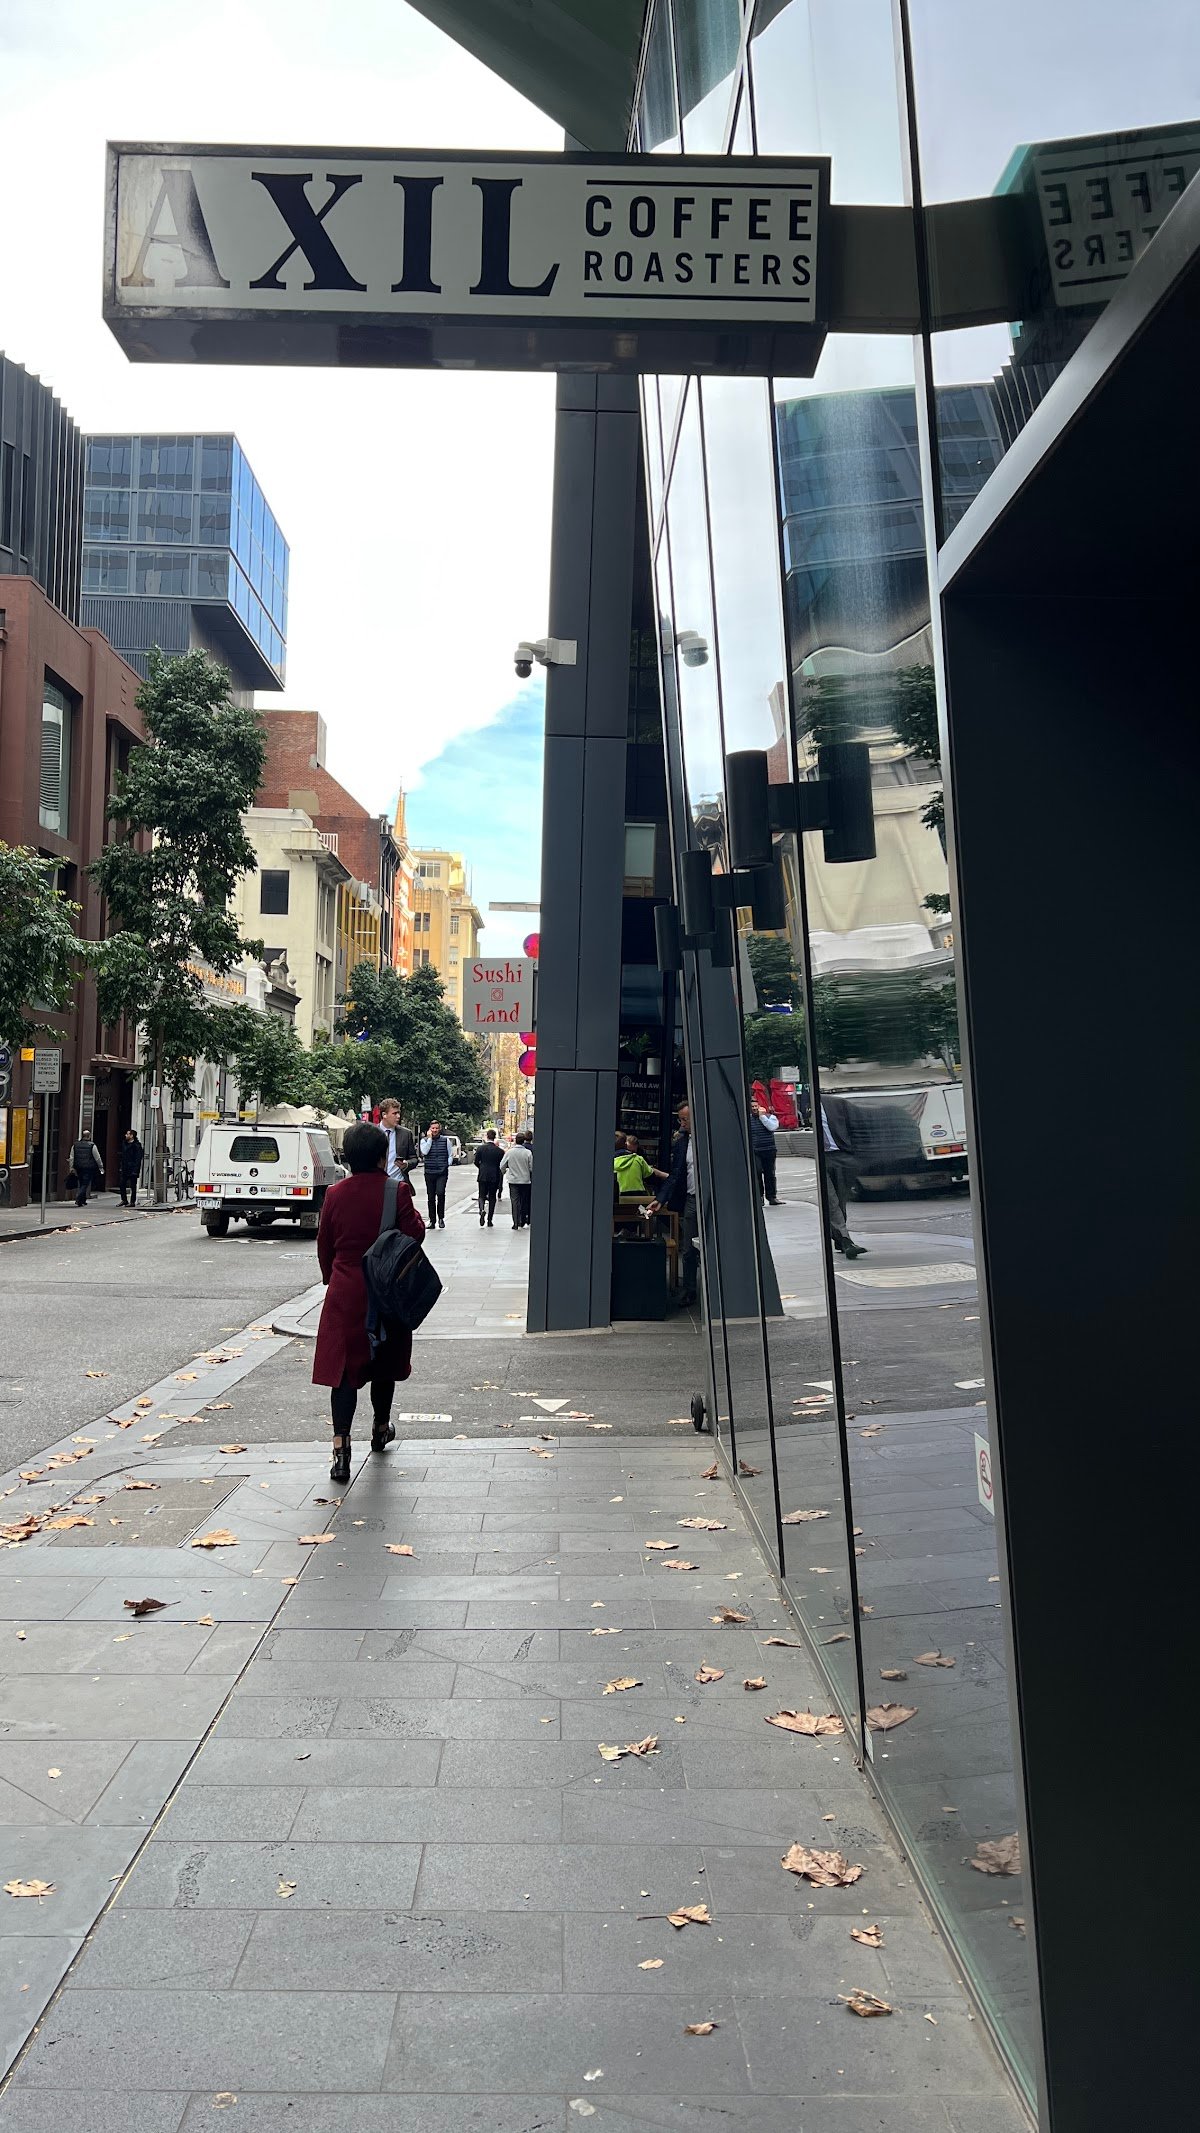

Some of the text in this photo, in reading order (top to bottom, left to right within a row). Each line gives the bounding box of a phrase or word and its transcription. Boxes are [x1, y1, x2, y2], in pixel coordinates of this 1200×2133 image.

[121, 168, 560, 297] AXIL
[584, 194, 813, 241] COFFEE
[583, 251, 813, 286] ROASTERS
[472, 962, 522, 983] Sushi
[475, 1001, 520, 1023] Land
